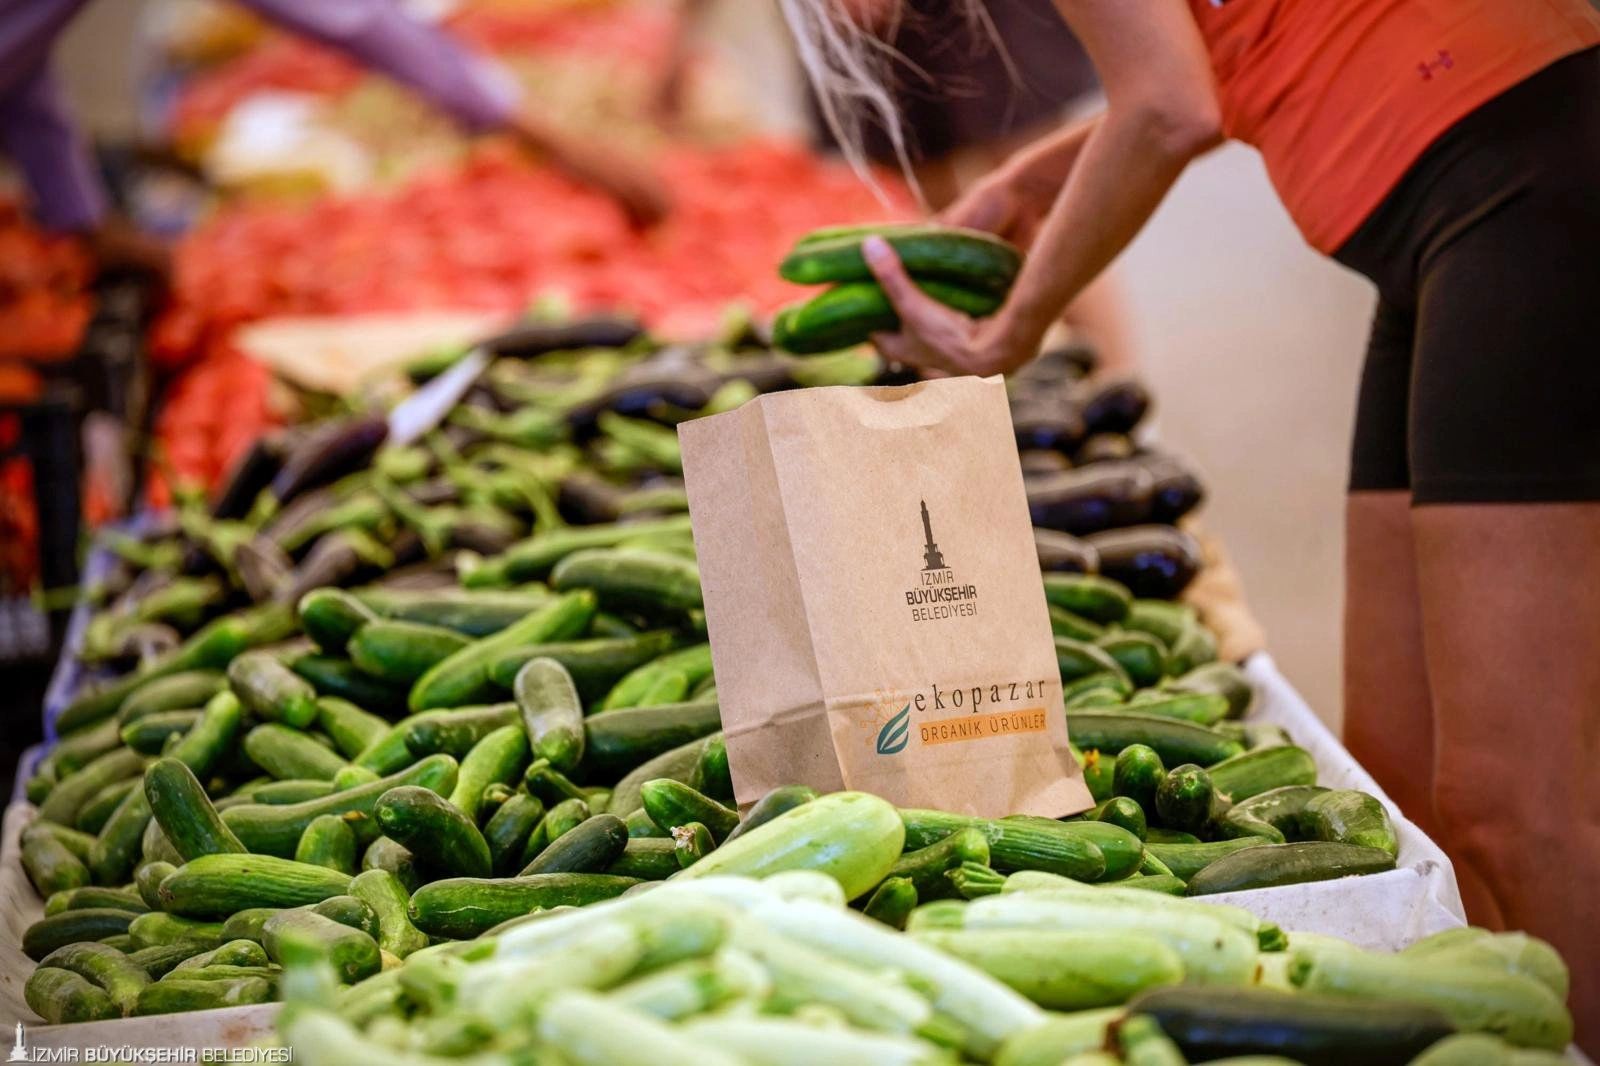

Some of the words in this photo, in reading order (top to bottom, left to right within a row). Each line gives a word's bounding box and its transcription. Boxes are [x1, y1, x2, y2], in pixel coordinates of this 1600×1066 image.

[920, 570, 954, 586] İZMİR
[905, 584, 978, 605] BÜYÜKŞEHİR
[912, 602, 978, 622] BELEDİYESİ
[914, 679, 1045, 713] ekopazar
[921, 718, 983, 742] ORGANİK
[989, 714, 1046, 733] ÜRÜNLER
